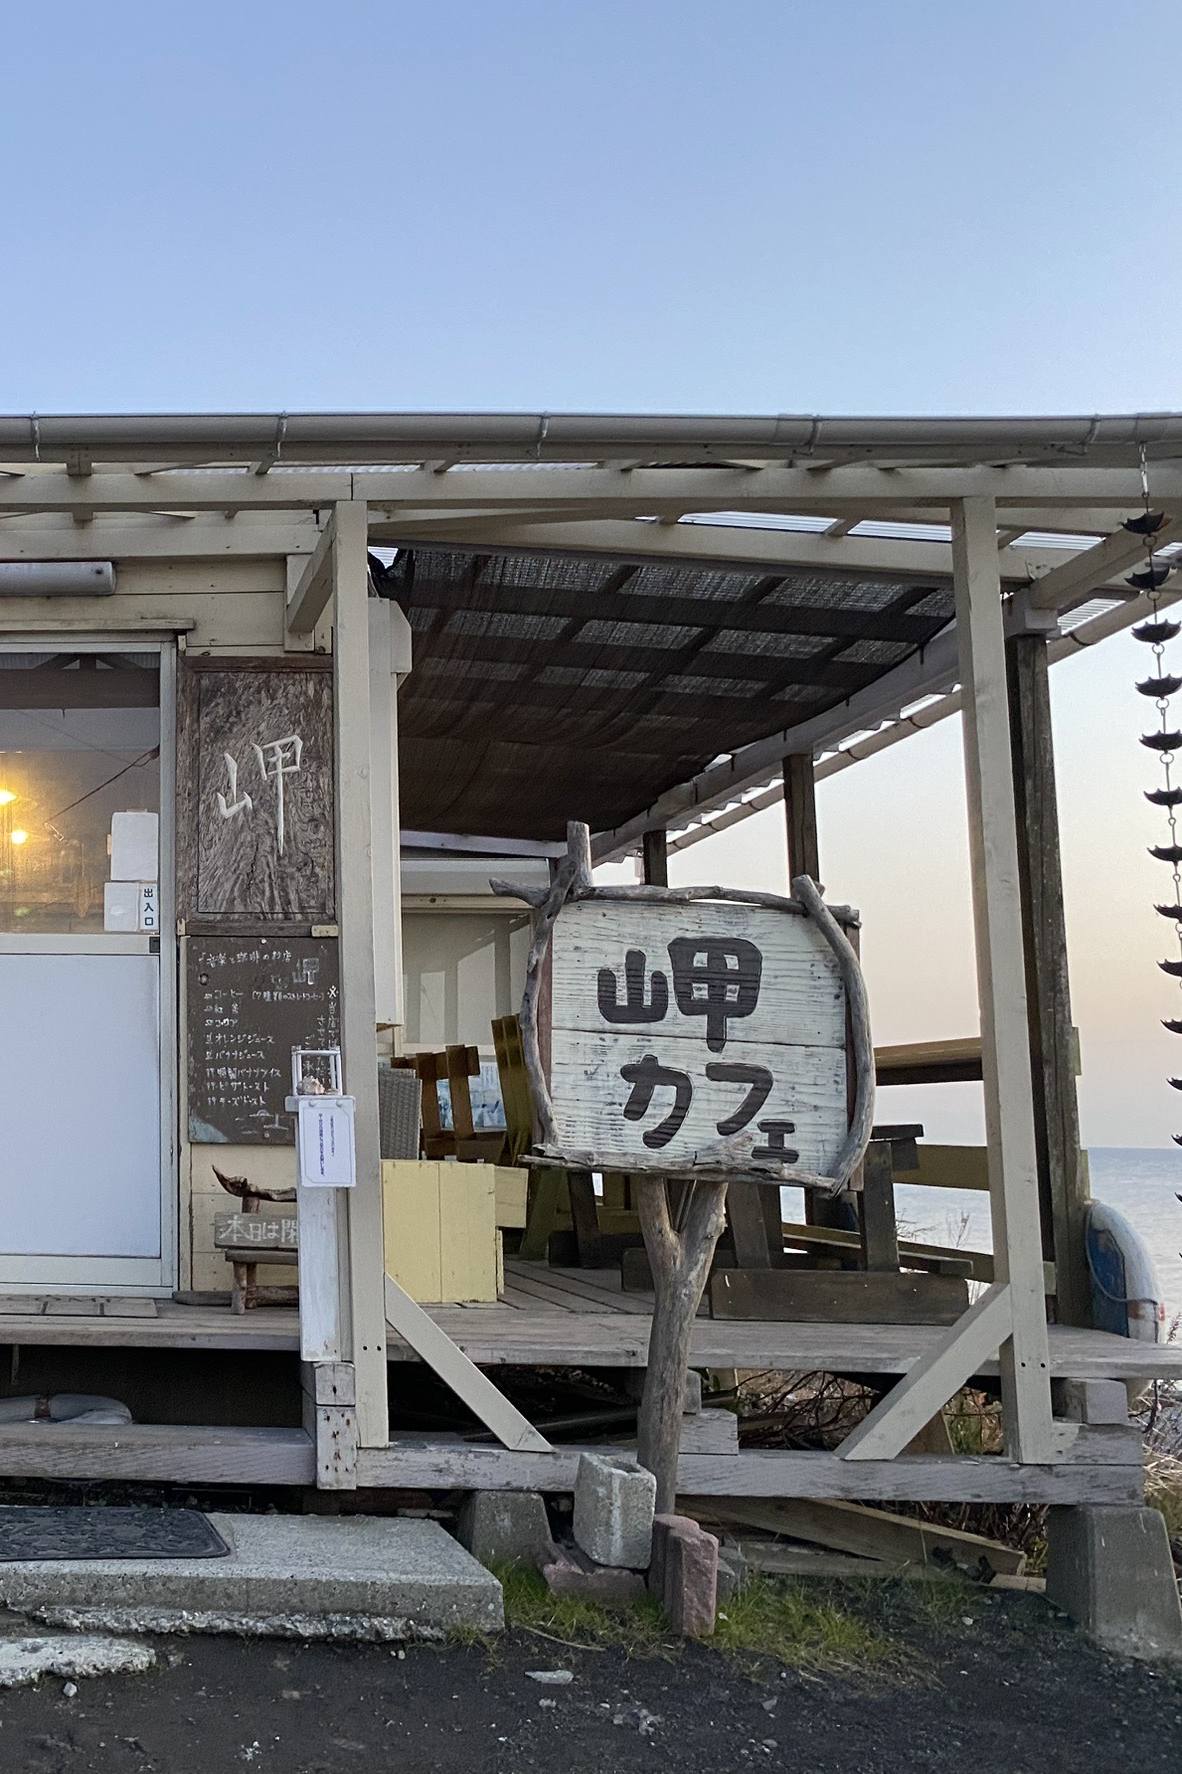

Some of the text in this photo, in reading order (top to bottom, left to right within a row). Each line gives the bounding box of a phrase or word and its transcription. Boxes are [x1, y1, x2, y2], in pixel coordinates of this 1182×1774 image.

[216, 734, 304, 857] 岬
[143, 888, 155, 926] 出入口
[596, 935, 764, 1054] 岬
[215, 1033, 275, 1044] オレンジジュース
[215, 1049, 265, 1060] バナナジュース
[619, 1053, 800, 1165] カフェ
